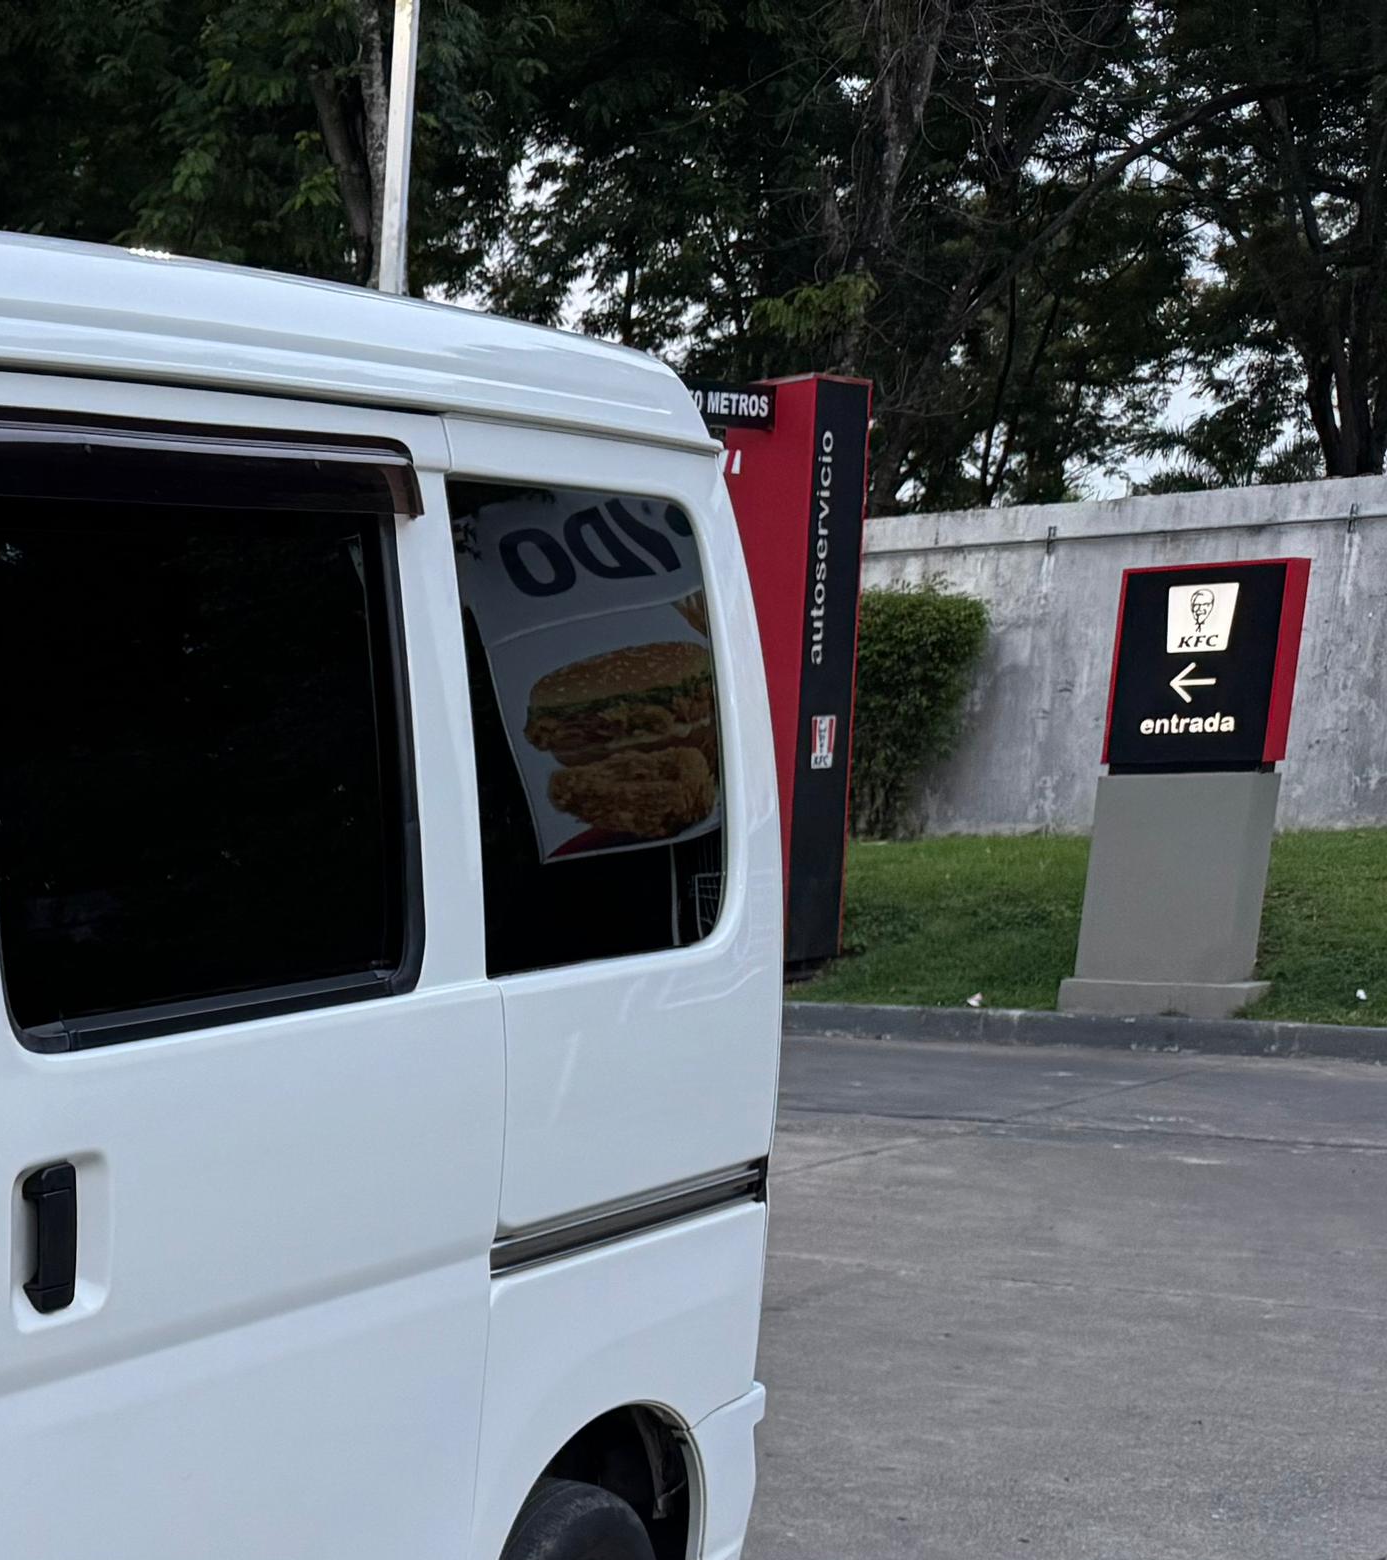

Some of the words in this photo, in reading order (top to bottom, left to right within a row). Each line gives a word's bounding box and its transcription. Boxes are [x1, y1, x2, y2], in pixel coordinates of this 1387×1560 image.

[707, 390, 769, 418] METROS
[810, 429, 834, 666] autoservicio
[1177, 634, 1219, 648] KFC
[1139, 712, 1235, 735] entrada
